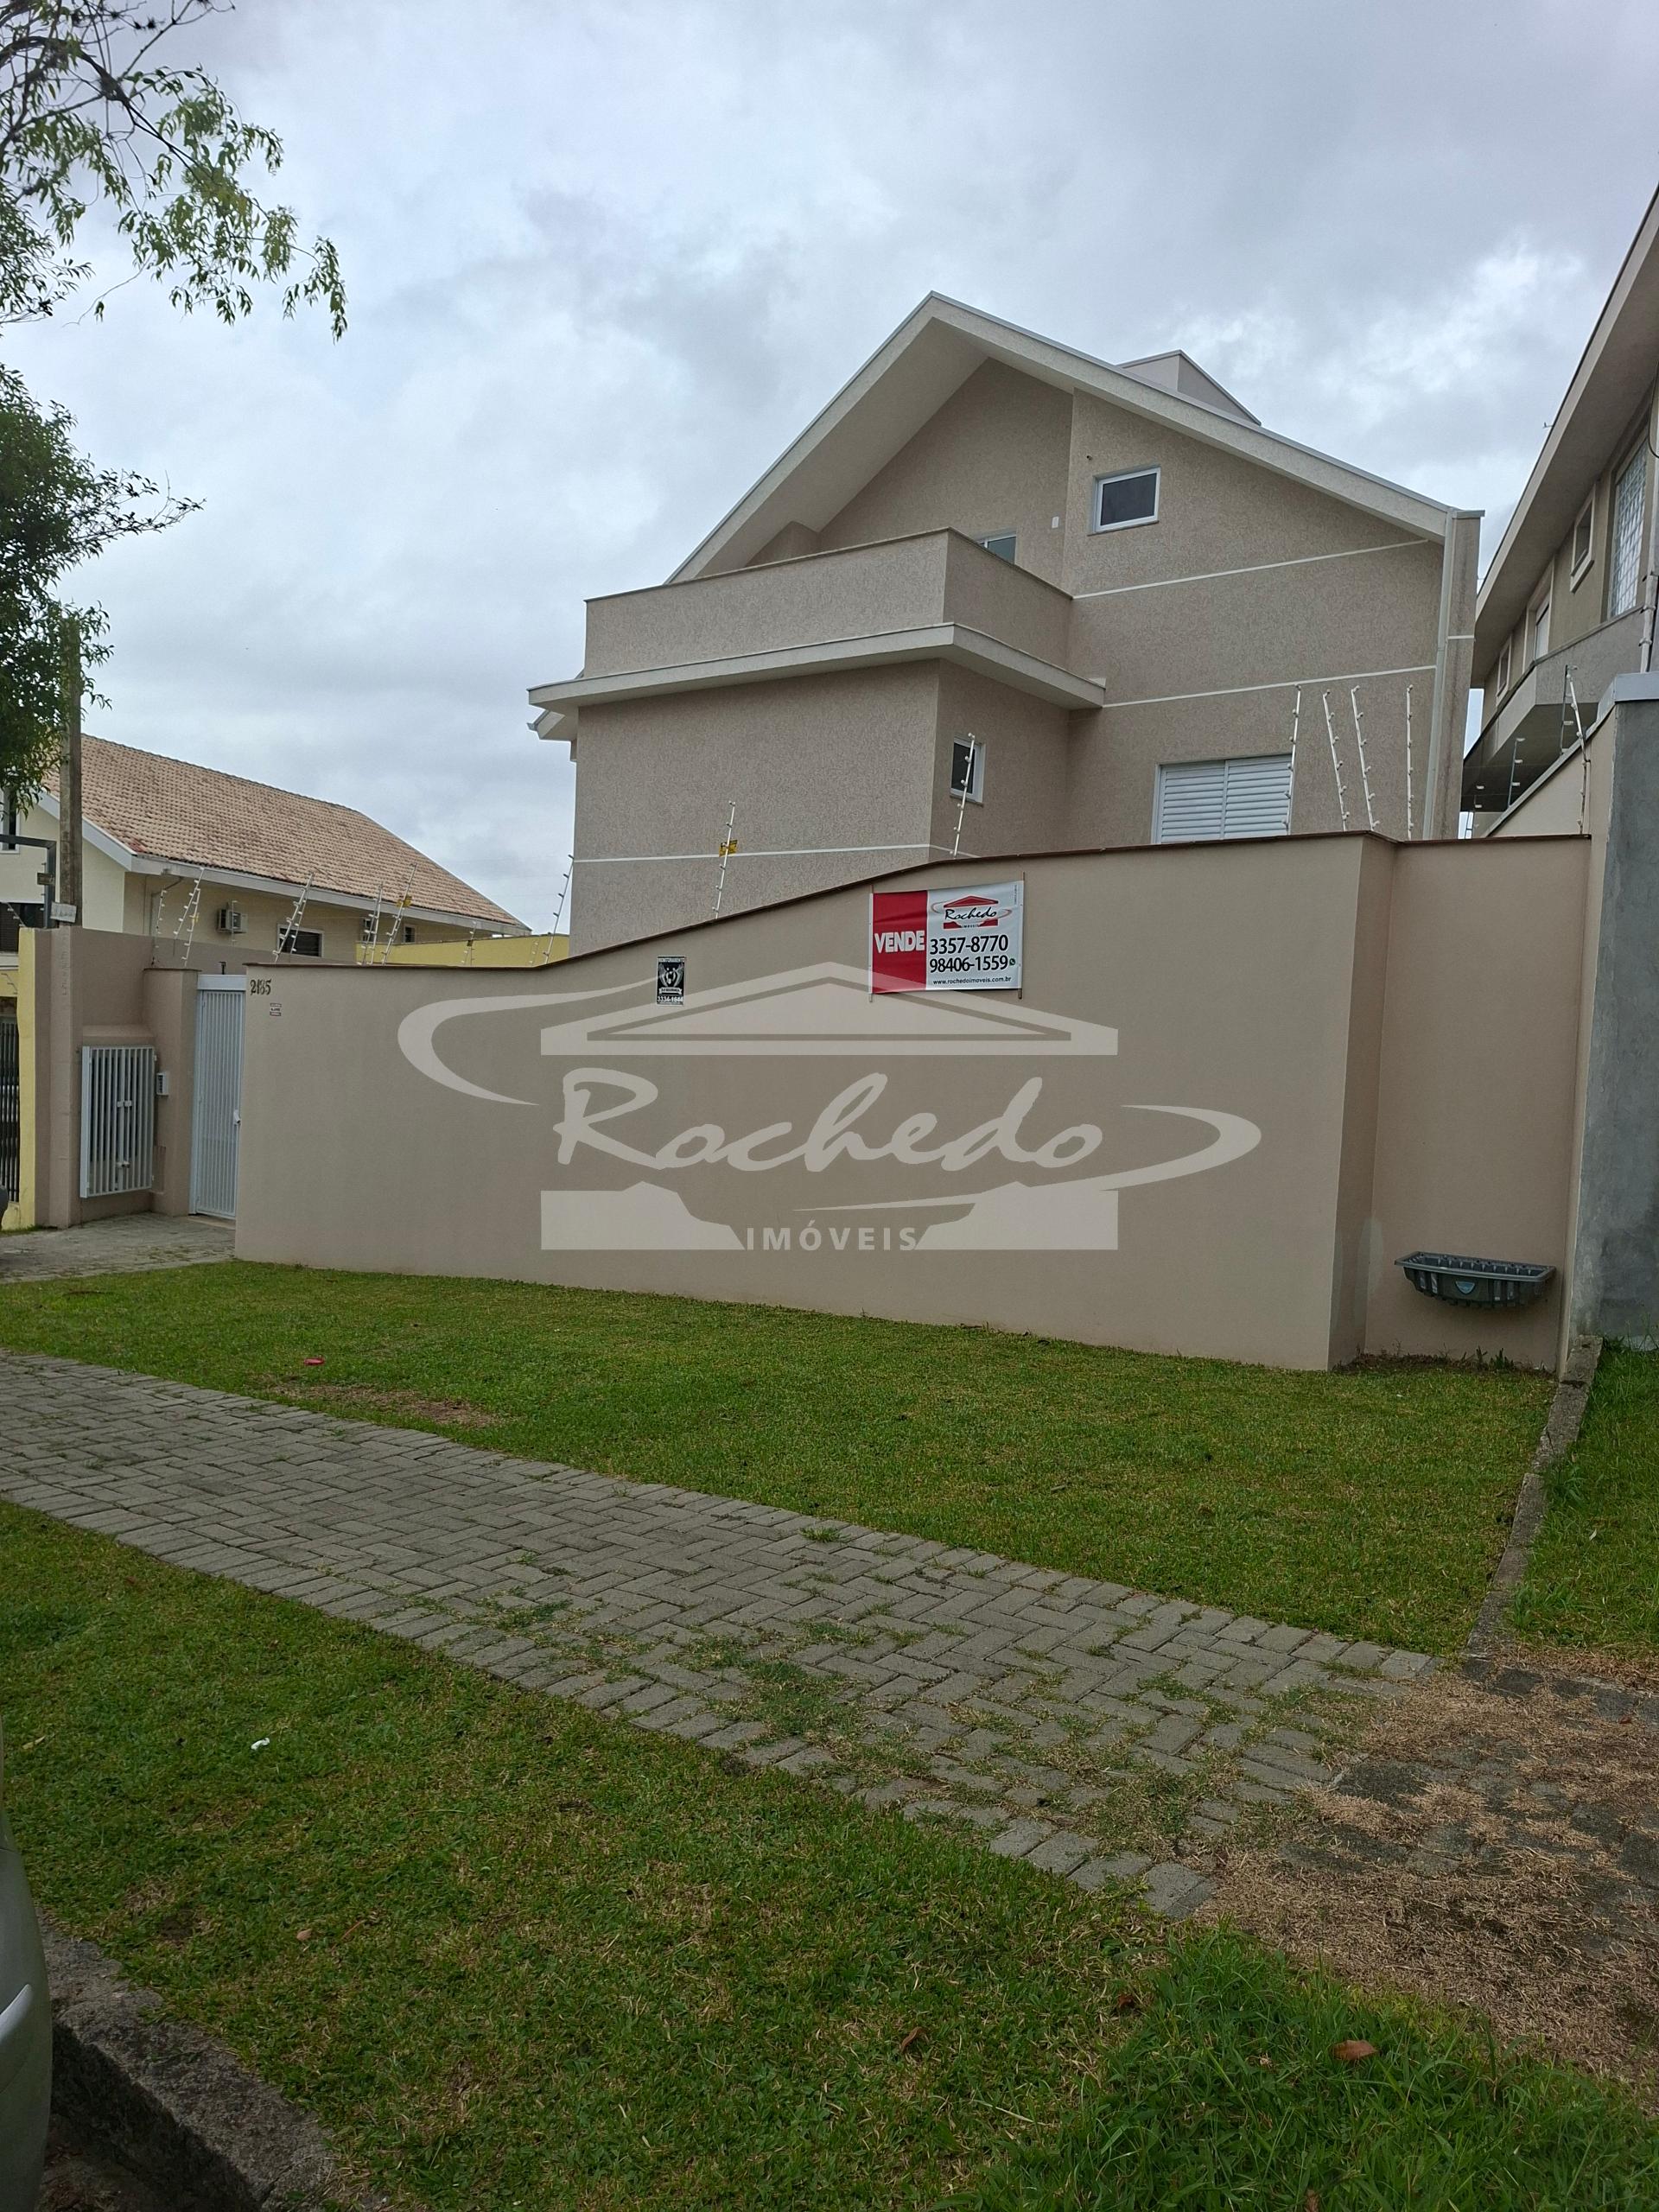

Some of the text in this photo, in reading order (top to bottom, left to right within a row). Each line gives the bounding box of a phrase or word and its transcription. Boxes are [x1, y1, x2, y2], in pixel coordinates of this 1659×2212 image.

[944, 907, 997, 920] Rochedo
[874, 930, 925, 953] VENDE
[930, 934, 1008, 955] 3357-8770
[930, 955, 1008, 973] 98406-1559
[933, 976, 1012, 985] www.rochedoimoveis.com.br
